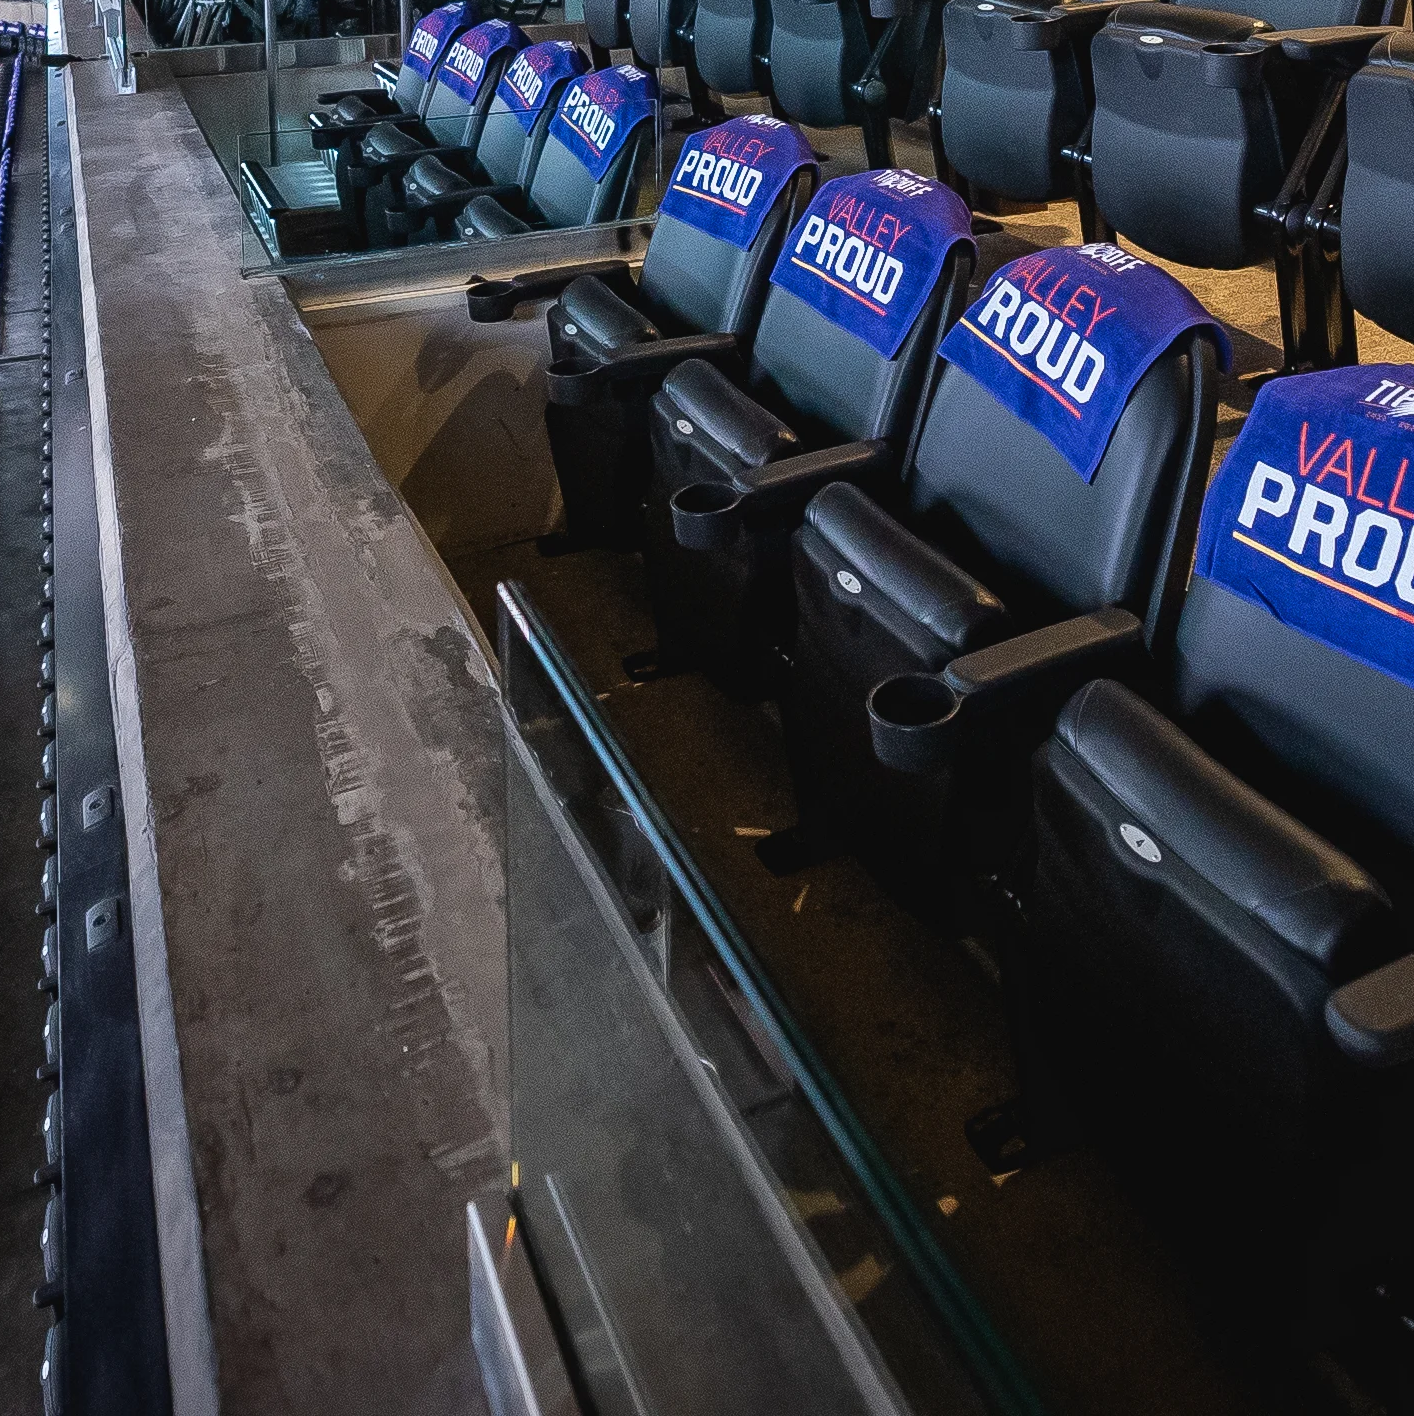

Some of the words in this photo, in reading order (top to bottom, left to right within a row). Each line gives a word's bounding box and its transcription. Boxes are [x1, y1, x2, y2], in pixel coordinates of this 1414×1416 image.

[410, 28, 439, 60] PROUD
[445, 41, 484, 82] PROUD
[508, 53, 543, 106] PROUD
[563, 85, 616, 151] PROUD
[702, 130, 775, 166] VALLEY
[676, 149, 763, 207] PROUD
[828, 191, 912, 253] VALLEY
[795, 214, 904, 305] PROUD
